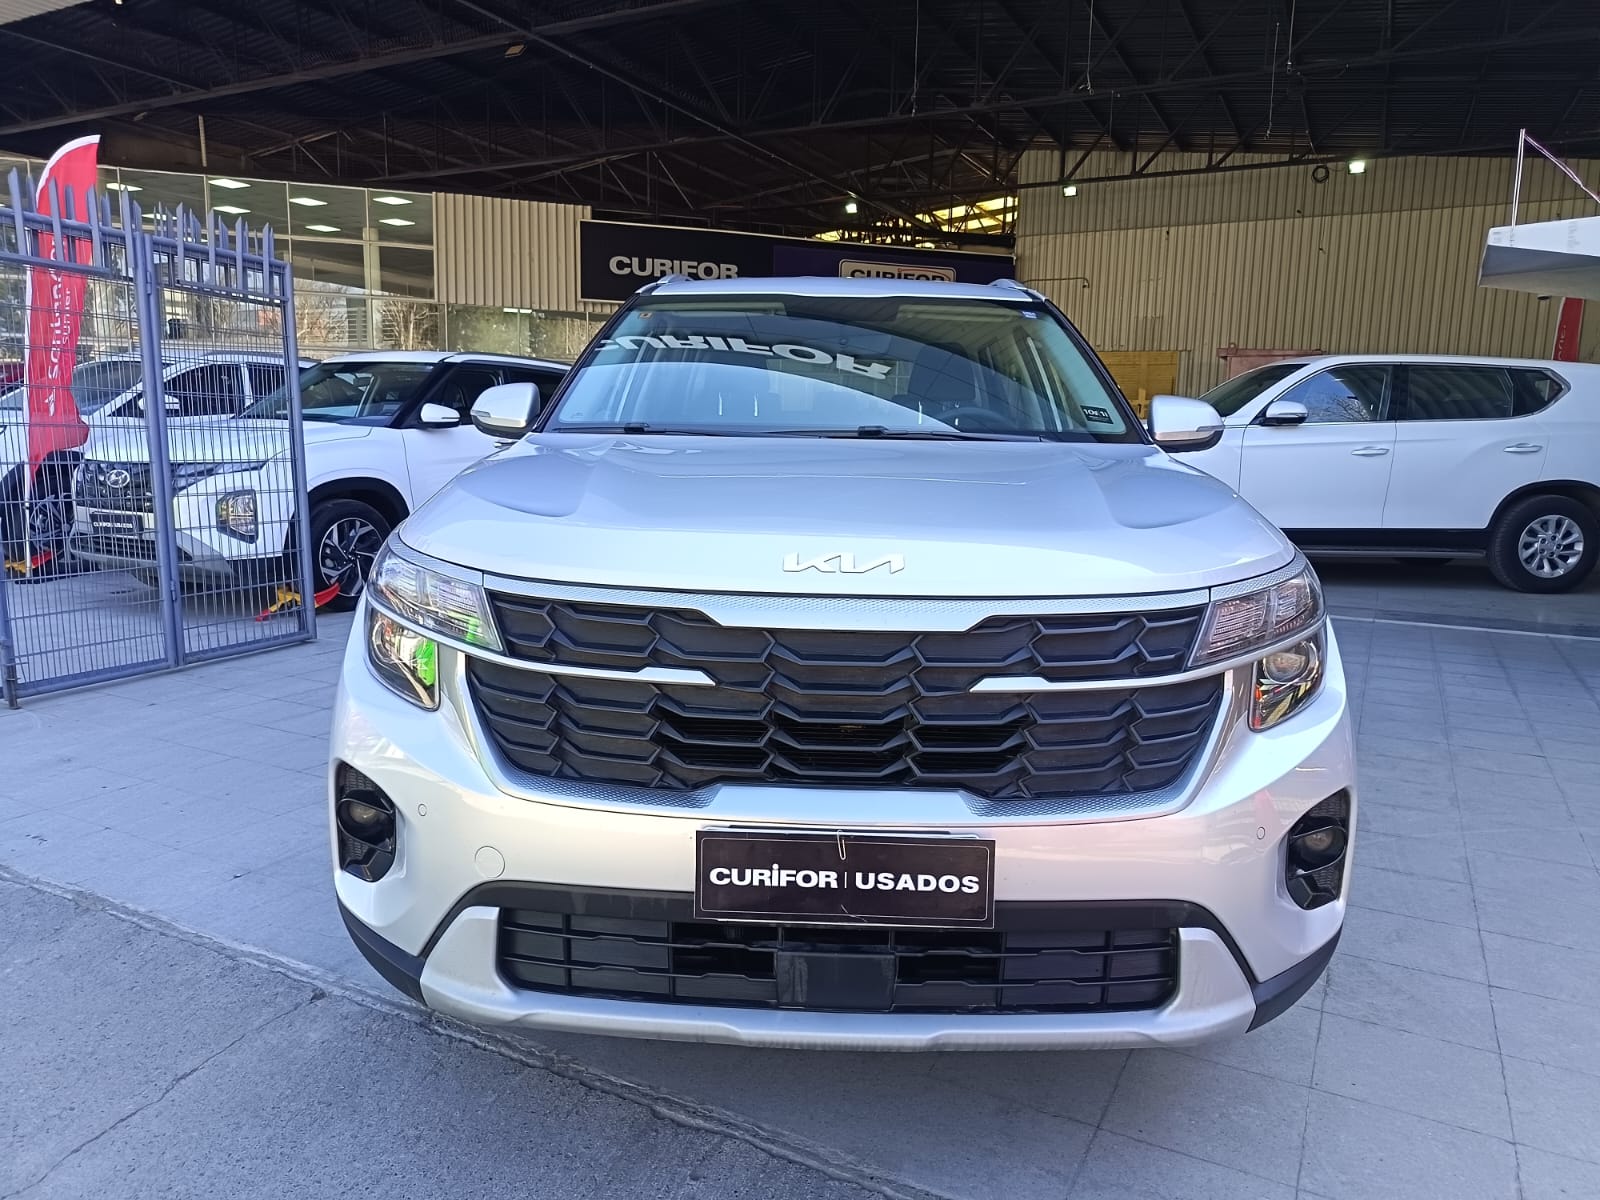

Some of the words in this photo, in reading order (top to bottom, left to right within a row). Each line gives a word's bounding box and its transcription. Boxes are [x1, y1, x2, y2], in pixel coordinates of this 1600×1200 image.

[609, 255, 739, 280] CURIFOR
[783, 552, 905, 574] KIA
[709, 863, 838, 888] CURIFOR
[855, 872, 980, 893] USADOS
